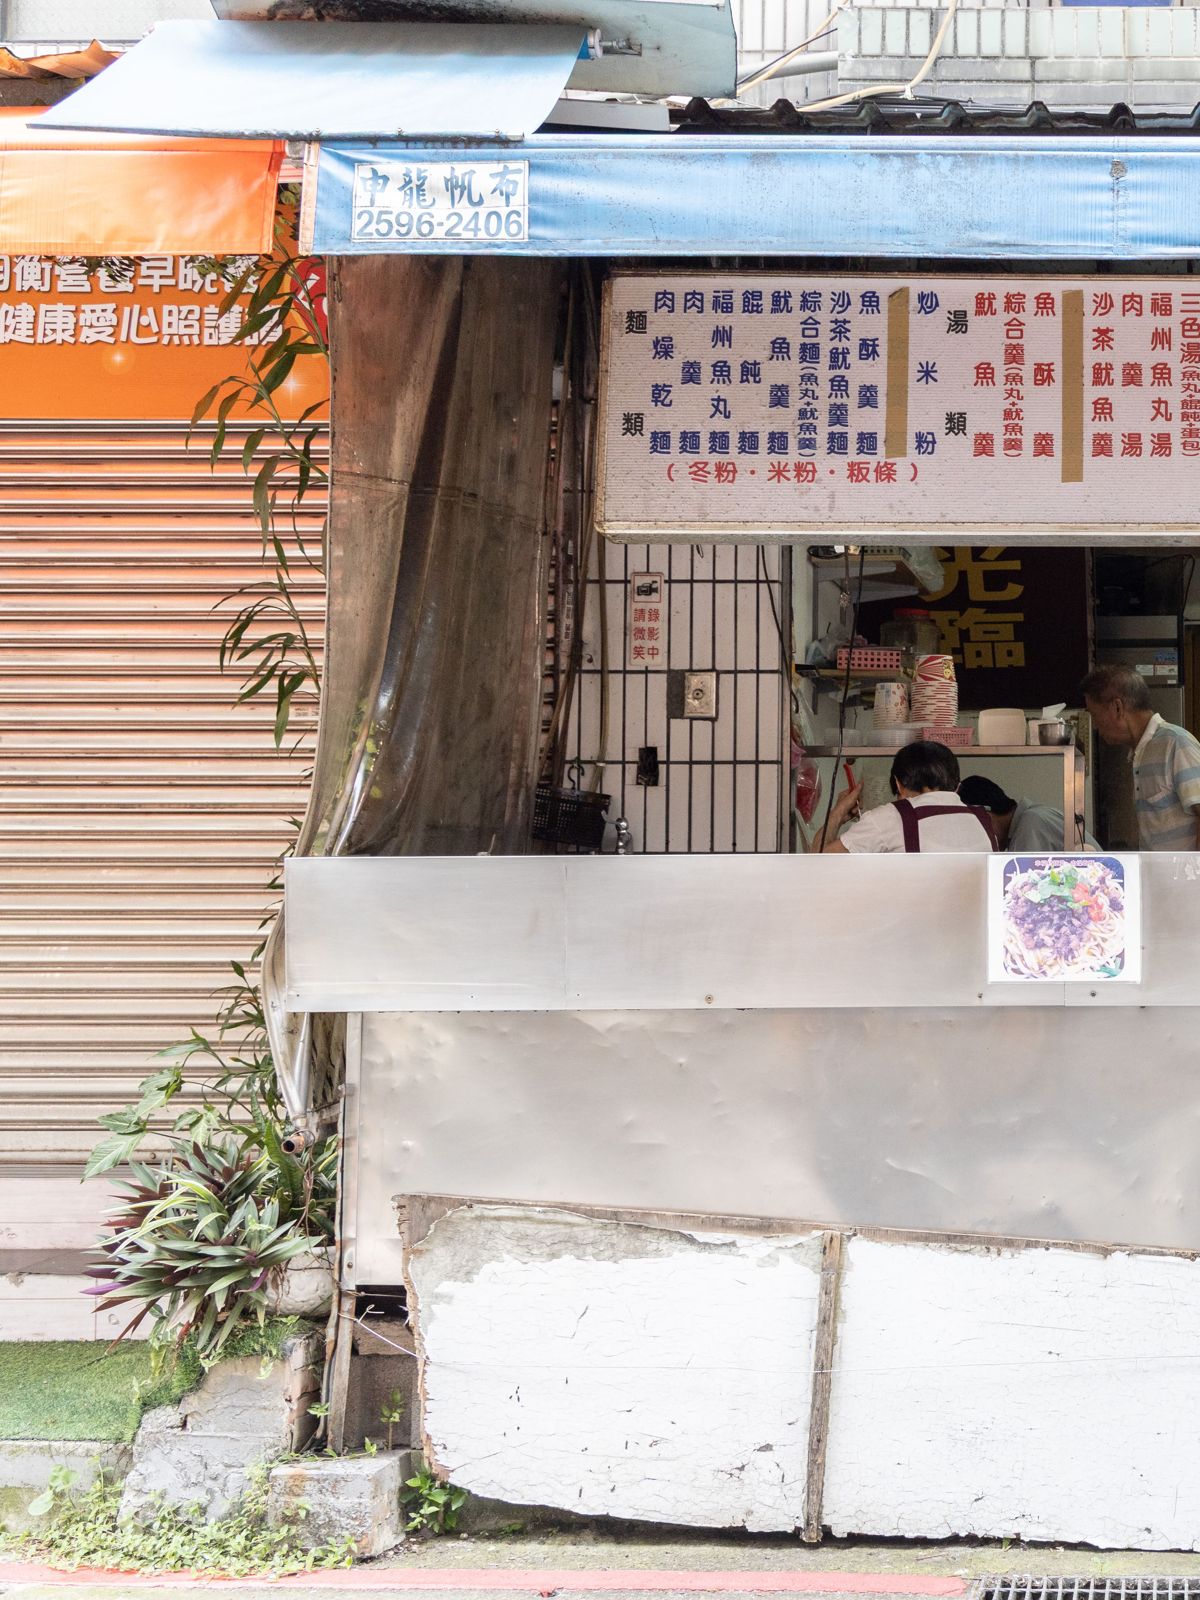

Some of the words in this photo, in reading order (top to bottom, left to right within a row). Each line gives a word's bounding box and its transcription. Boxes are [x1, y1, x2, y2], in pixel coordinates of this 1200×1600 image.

[356, 209, 524, 238] 2596-2406
[622, 309, 648, 437] 麵類
[649, 290, 675, 455] 肉燥乾麵
[679, 290, 704, 455] 肉羹麵
[708, 290, 734, 455] 福州魚丸麵
[738, 290, 763, 455] 餛飩麵
[767, 290, 793, 455] 魷魚羹麵
[827, 290, 852, 456] 沙茶魷魚羹麵
[856, 290, 881, 456] 魚酥羹麵
[915, 291, 940, 456] 炒米粉
[945, 310, 969, 437] 湯類
[973, 292, 997, 458] 魷魚羹
[1032, 292, 1056, 458] 魚酥羹
[1091, 292, 1115, 458] 沙茶魷魚羹
[1121, 292, 1144, 458] 肉羹湯
[1150, 292, 1173, 458] 福州魚丸湯
[633, 608, 645, 660] 請微笑
[647, 608, 660, 660] 錄影中
